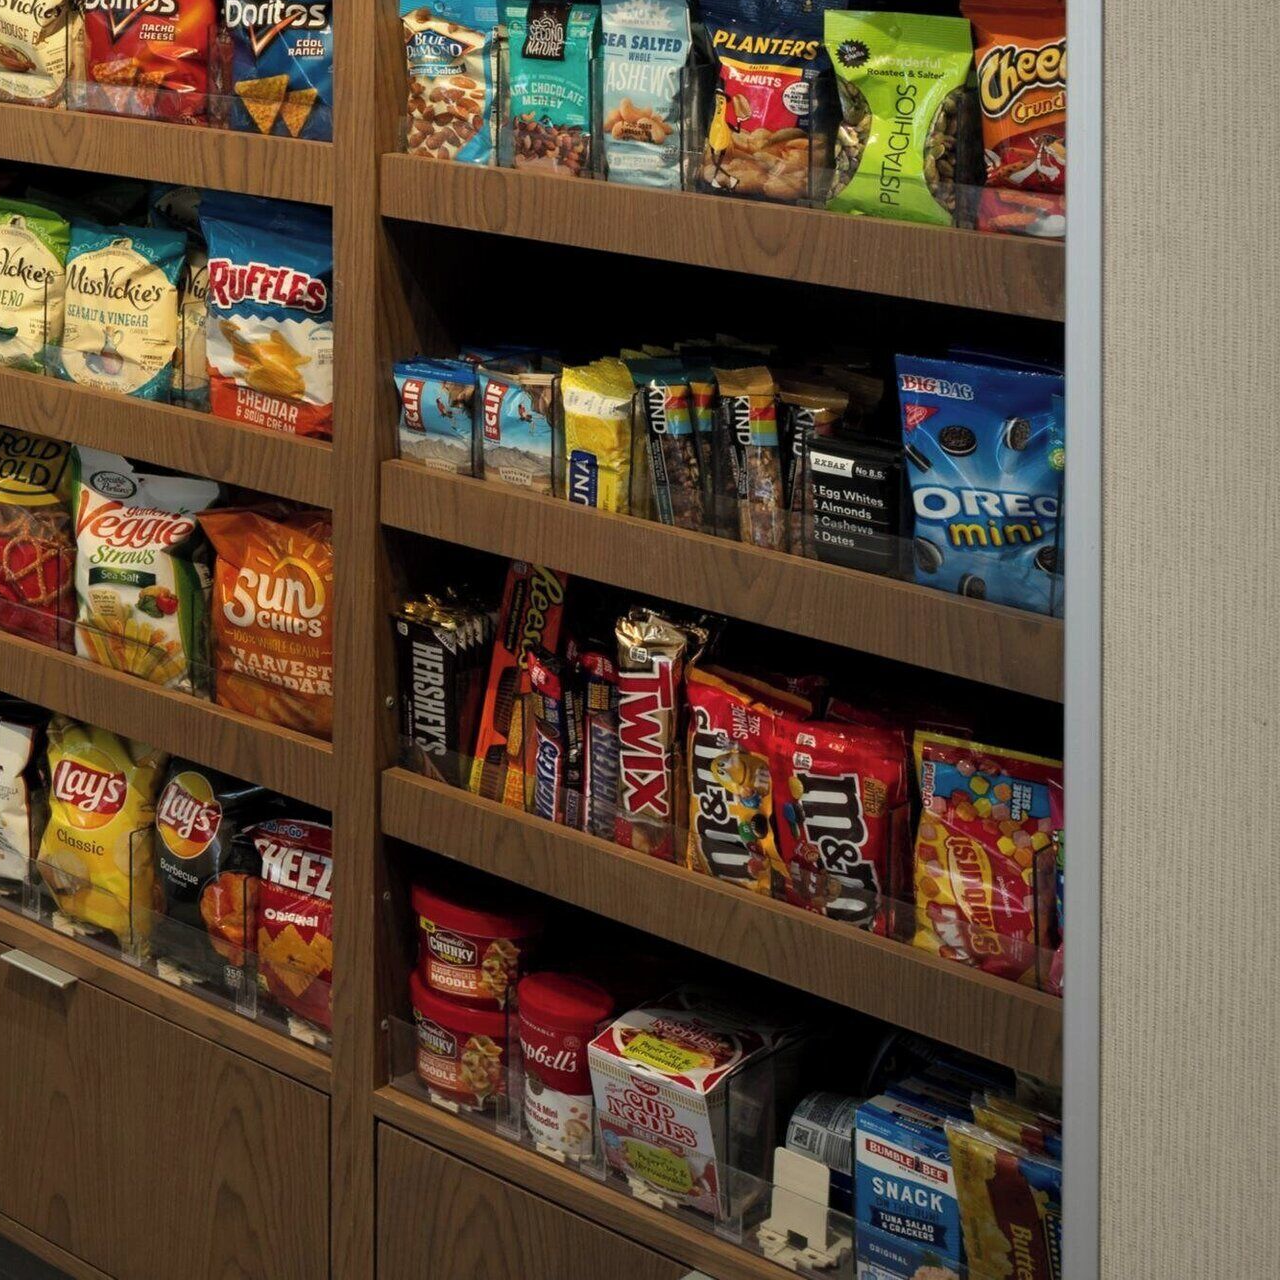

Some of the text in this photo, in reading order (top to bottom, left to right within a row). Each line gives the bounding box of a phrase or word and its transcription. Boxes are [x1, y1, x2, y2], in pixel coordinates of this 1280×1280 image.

[139, 31, 175, 41] CHEESE
[141, 23, 175, 33] NACHO
[414, 33, 446, 47] BLUE
[529, 24, 564, 43] SECOND
[288, 47, 325, 57] RANCH
[296, 38, 323, 48] COOL
[525, 41, 563, 58] NATURE
[602, 32, 683, 53] SEA SALTED
[712, 29, 820, 61] PLANTERS
[628, 52, 651, 62] WHOLE
[873, 55, 942, 69] Wonderful
[605, 61, 677, 103] ASHEWS
[727, 68, 783, 88] PEANUTS
[867, 68, 905, 78] Roasted
[521, 95, 564, 110] MEDLEY
[531, 82, 586, 106] CHOCOLATE
[879, 83, 918, 207] PISTACHIOS
[65, 263, 164, 311] Miss Vickie's
[207, 258, 328, 315] RUFFLES
[107, 310, 149, 328] VINEGAR
[901, 374, 975, 401] BIG BAG
[236, 388, 299, 425] CHEDDAR
[404, 382, 420, 421] CLIF
[485, 383, 504, 424] CLIF
[648, 385, 668, 434] KIND
[734, 395, 752, 446] KIND
[812, 457, 848, 471] RXBAR
[855, 466, 868, 475] No
[819, 486, 884, 508] Egg Whites
[913, 486, 1058, 519] OREO
[76, 489, 196, 549] Veggie
[820, 502, 873, 520] Almonds
[820, 517, 874, 536] Cashews
[948, 520, 1043, 549] mini
[822, 533, 855, 548] Dates
[90, 544, 156, 566] Straws
[100, 569, 140, 585] Sea Salt
[255, 610, 324, 638] CHIPS
[229, 645, 333, 681] HARVEST
[289, 641, 320, 660] GRAIN
[412, 640, 447, 758] HERSHEY'S
[619, 661, 674, 816] TWIX
[53, 760, 125, 813] Lay's
[923, 763, 935, 810] Original
[1021, 785, 1033, 810] SIZE
[158, 783, 219, 839] Lay's
[1011, 782, 1022, 821] SHARE
[56, 828, 105, 857] Classic
[159, 856, 200, 887] Barbecue
[945, 834, 1003, 956] Starburst
[429, 935, 475, 963] CHUNKY
[430, 972, 478, 990] NOODLE
[624, 1089, 676, 1121] CUP
[606, 1095, 698, 1148] NOODLES
[867, 1139, 945, 1181] BUMBLE BEE
[871, 1176, 944, 1214] SNACK
[879, 1211, 935, 1234] TUNA SALAD
[889, 1223, 935, 1243] CRACKERS
[868, 1242, 909, 1266] ORIGINAL
